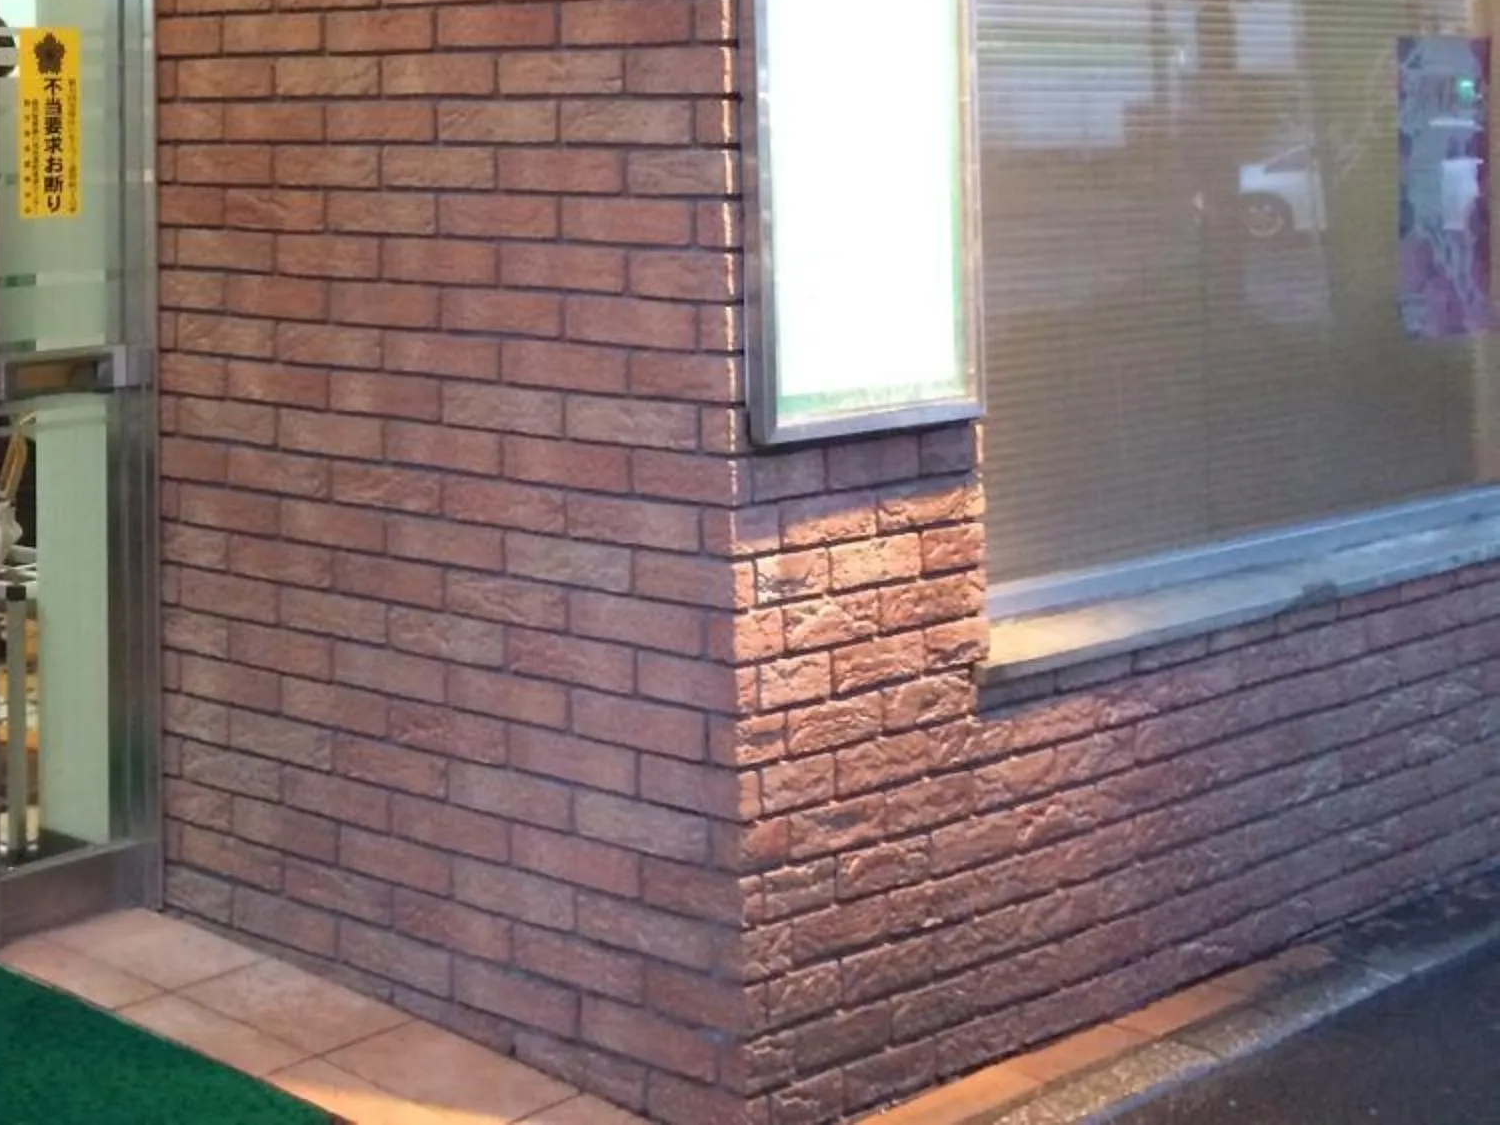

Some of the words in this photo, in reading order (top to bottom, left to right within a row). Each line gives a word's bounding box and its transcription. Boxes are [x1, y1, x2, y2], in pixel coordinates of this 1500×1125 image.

[43, 77, 64, 213] 不当要求お断り
